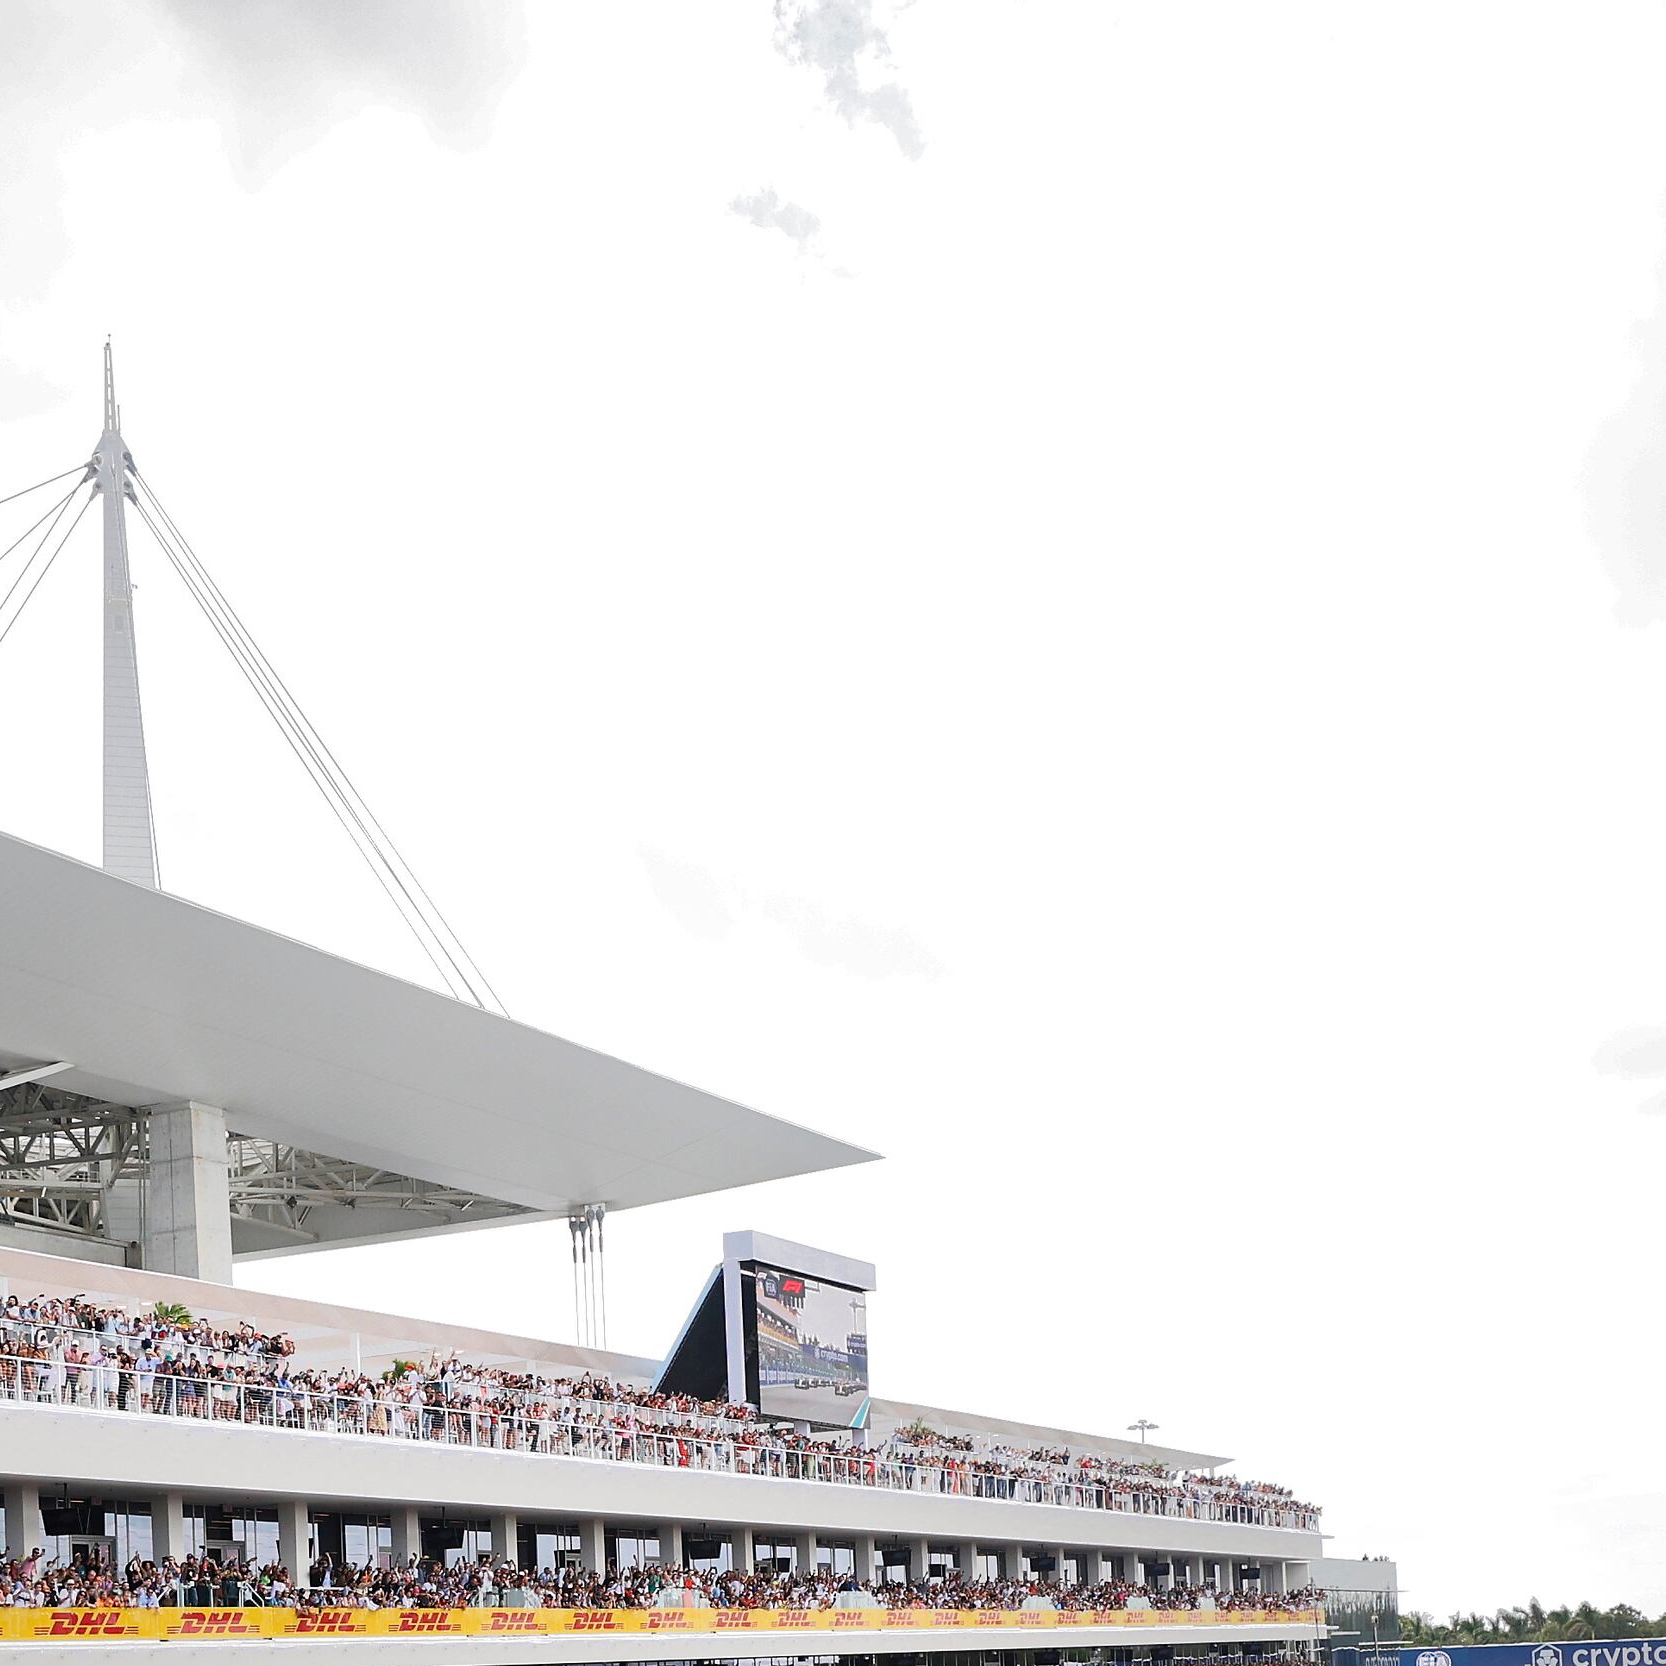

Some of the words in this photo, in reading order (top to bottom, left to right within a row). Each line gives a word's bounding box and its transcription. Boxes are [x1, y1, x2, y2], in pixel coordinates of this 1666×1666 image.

[49, 1612, 123, 1635] DHL
[180, 1612, 243, 1634] DHL
[295, 1612, 351, 1632] DHL
[398, 1612, 448, 1631] DHL
[490, 1612, 535, 1630] DHL
[573, 1612, 615, 1630] DHL
[648, 1612, 685, 1629] DHL
[715, 1612, 749, 1628] DHL
[777, 1612, 810, 1627] DHL
[835, 1612, 863, 1626] DHL
[886, 1612, 914, 1625] DHL
[935, 1612, 959, 1625] DHL
